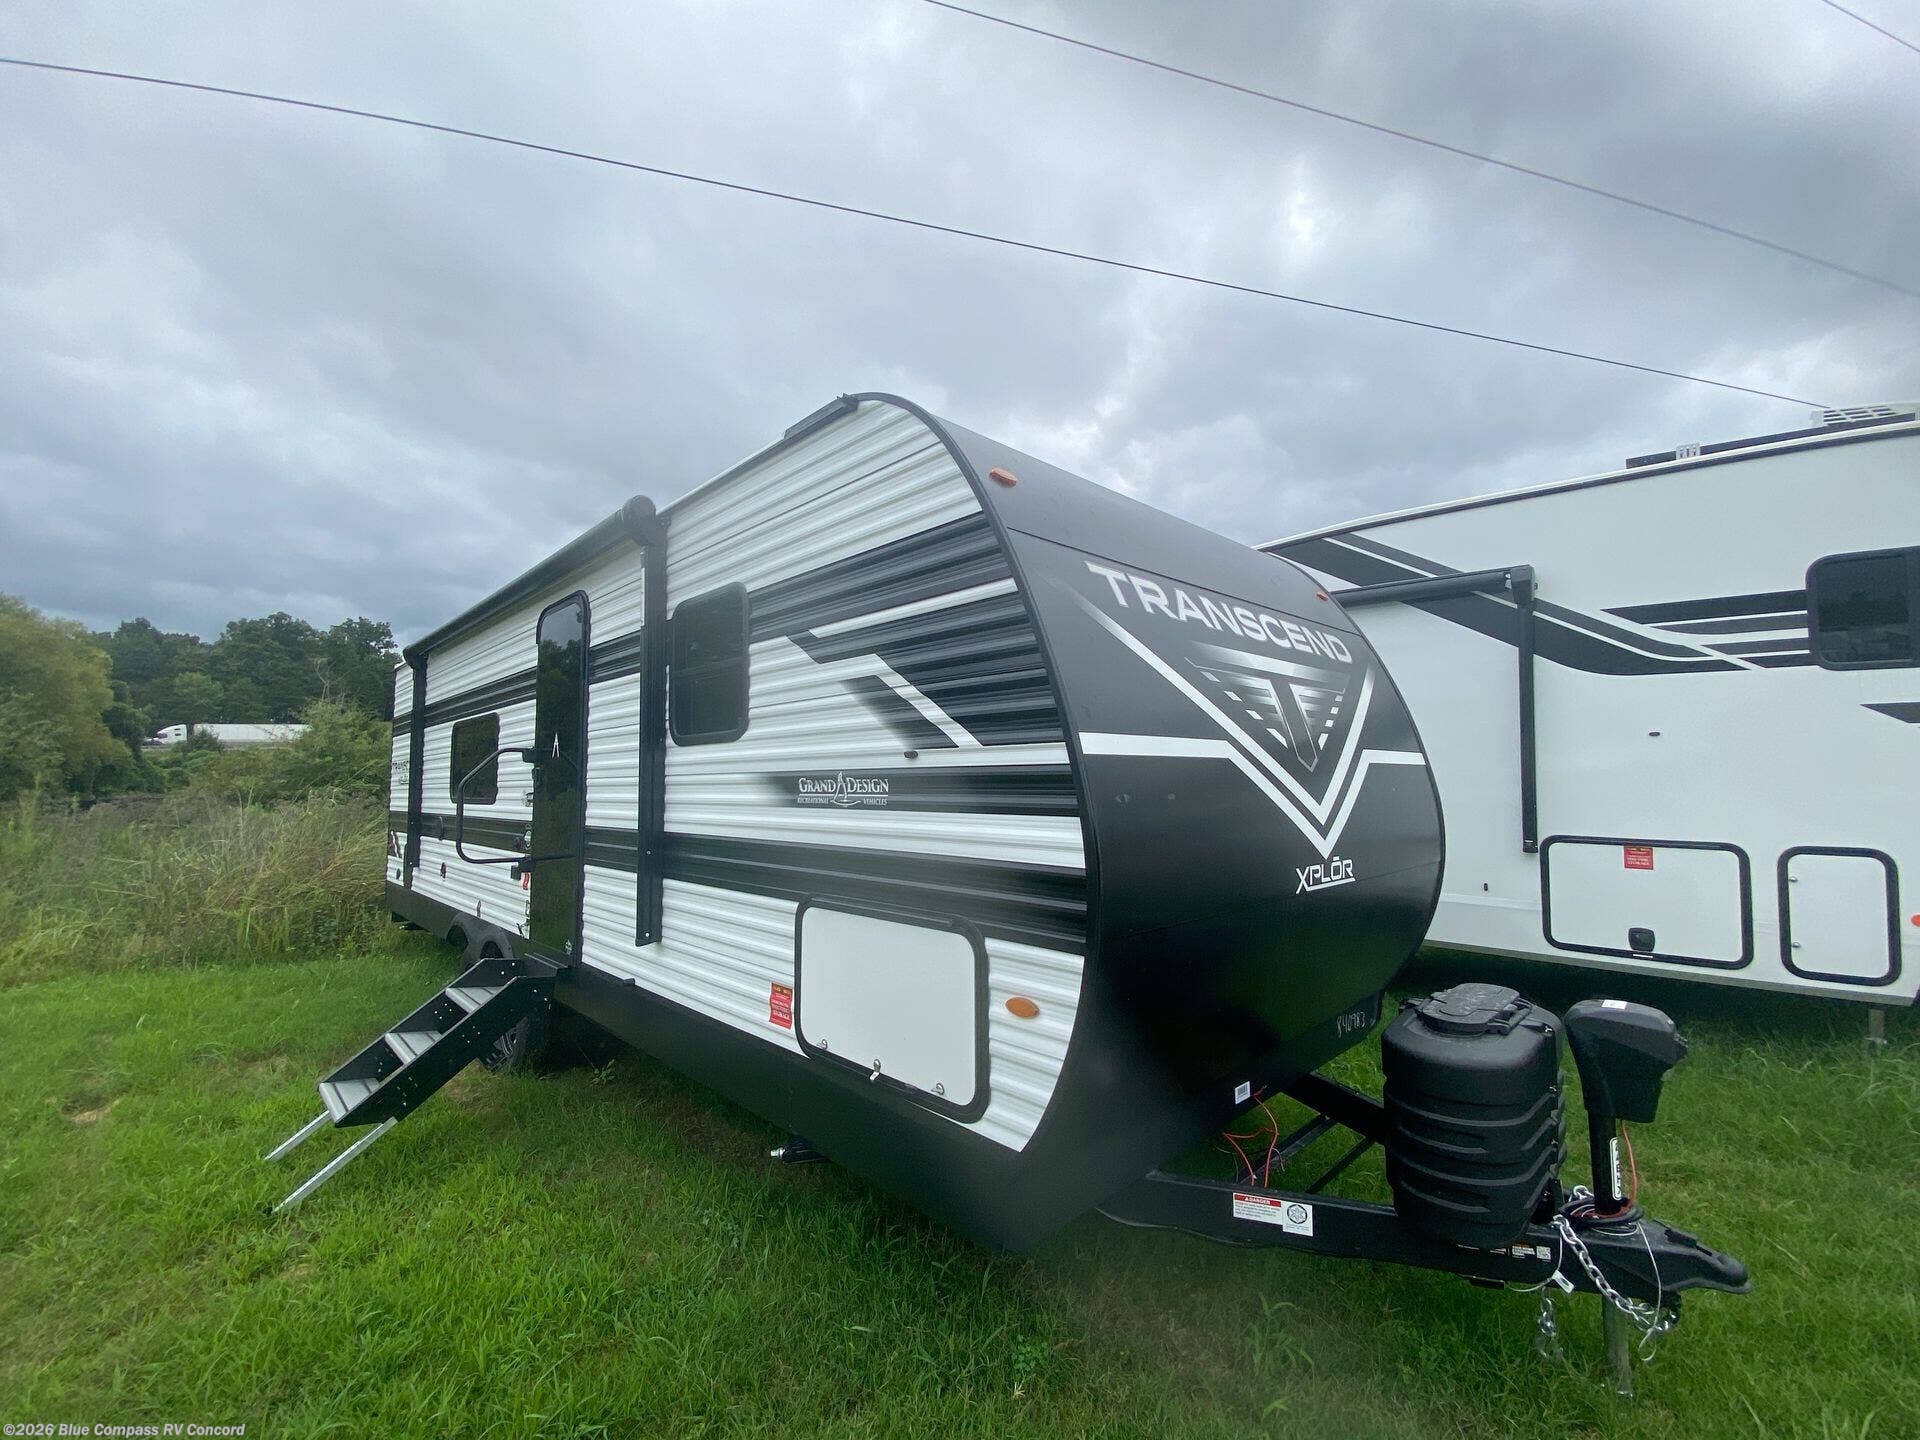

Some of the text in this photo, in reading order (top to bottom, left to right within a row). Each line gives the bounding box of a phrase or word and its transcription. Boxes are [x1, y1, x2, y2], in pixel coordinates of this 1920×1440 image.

[1084, 560, 1353, 664] TRANSCEND
[798, 777, 889, 793] GRAND DESIGN
